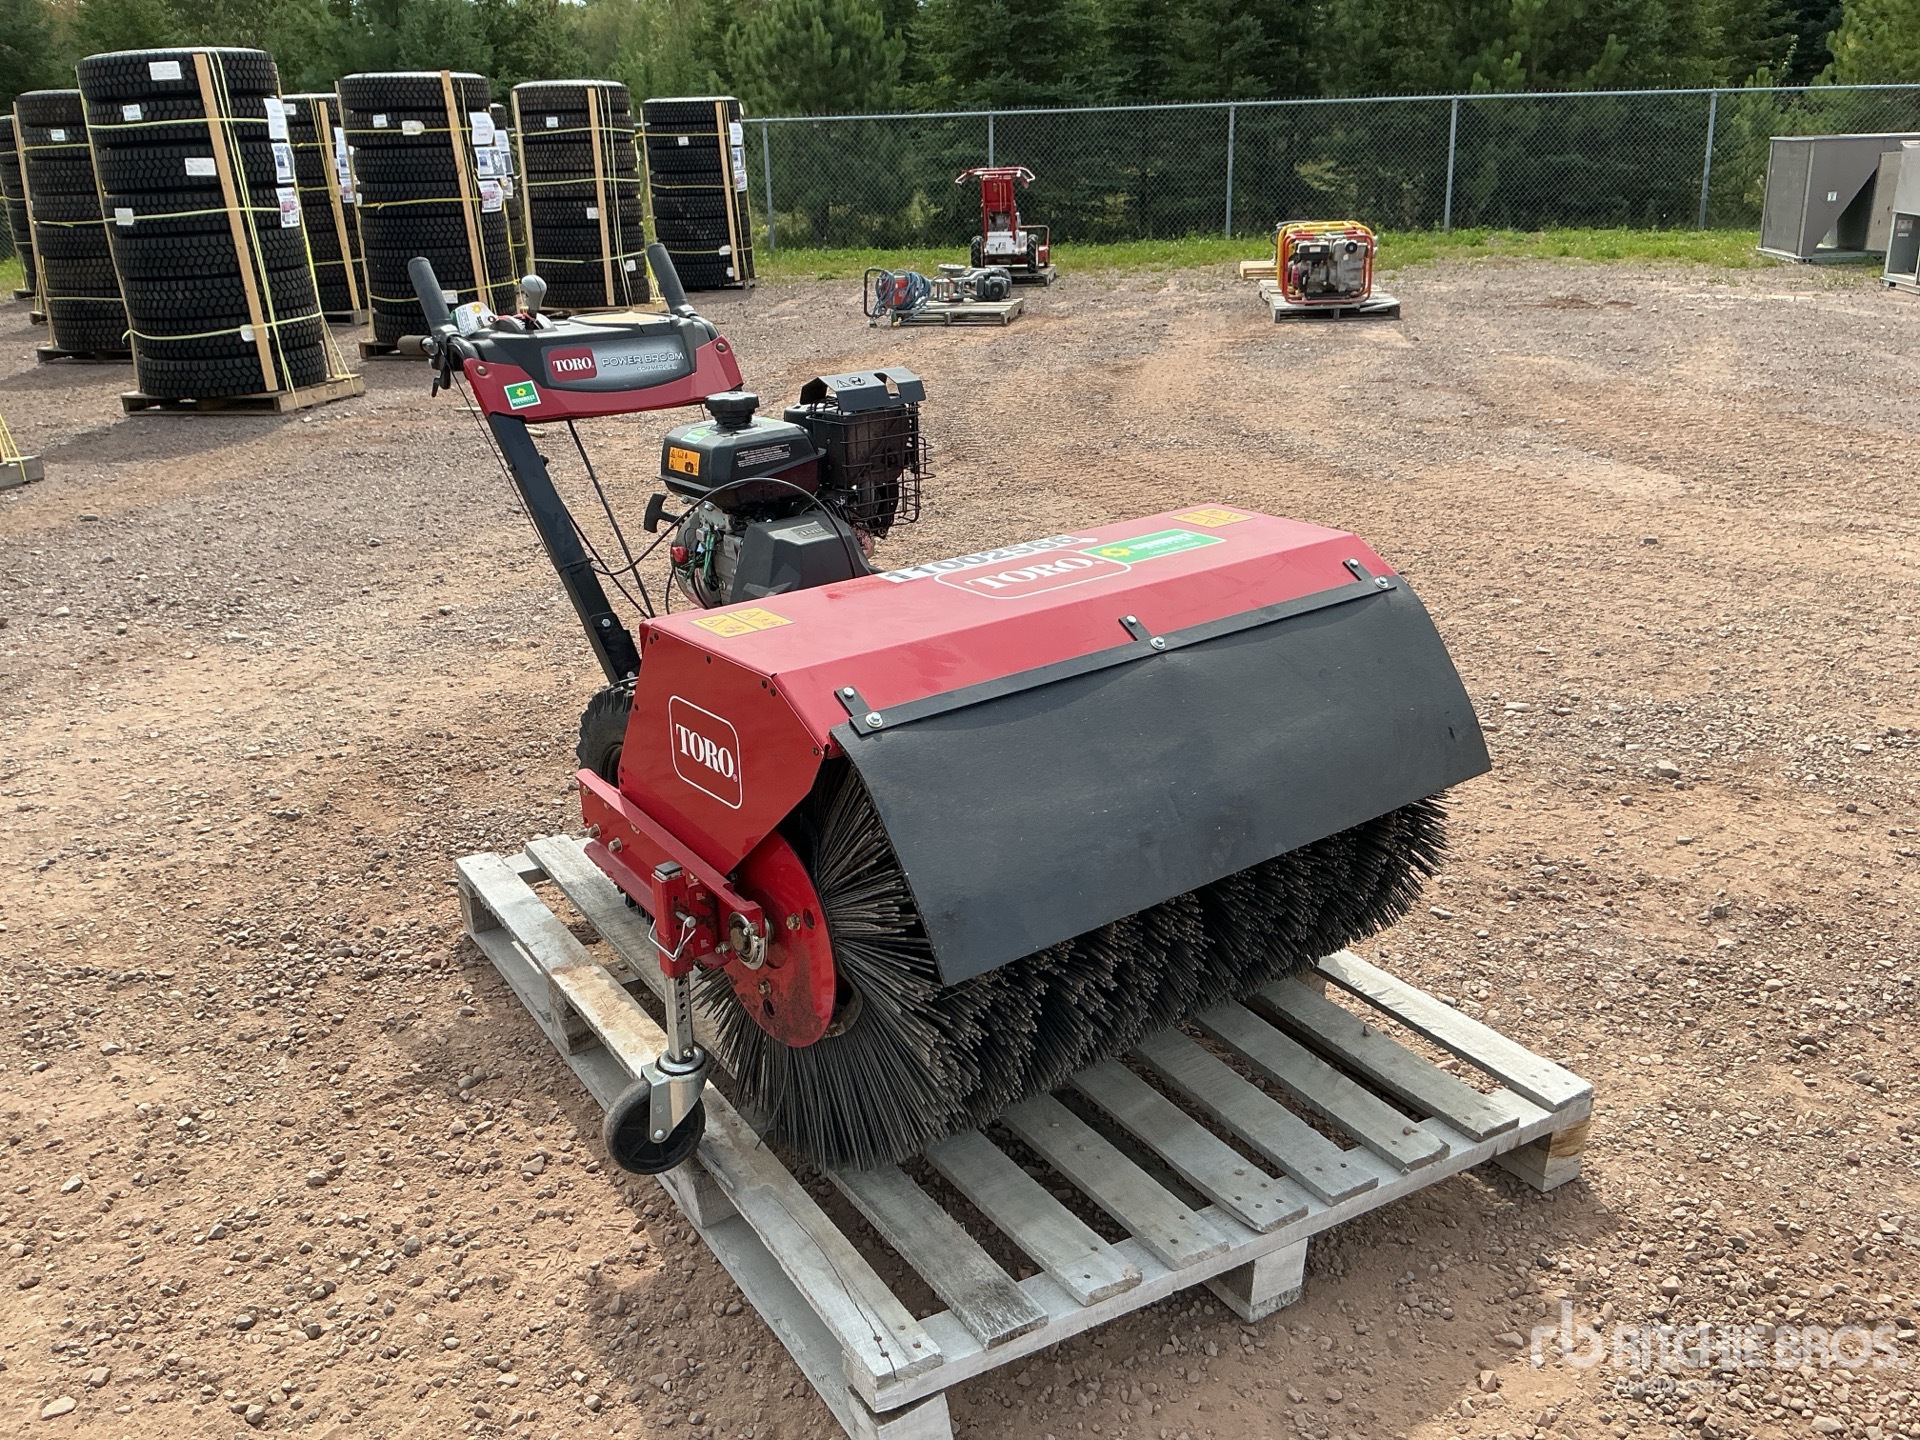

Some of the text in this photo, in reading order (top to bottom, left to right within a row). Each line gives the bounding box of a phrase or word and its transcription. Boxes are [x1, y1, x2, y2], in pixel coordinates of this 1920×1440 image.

[553, 357, 592, 372] TORO
[602, 352, 684, 366] POWER BROOM
[885, 535, 1082, 580] 11002566
[964, 557, 1095, 590] TORO
[675, 723, 735, 778] TORO
